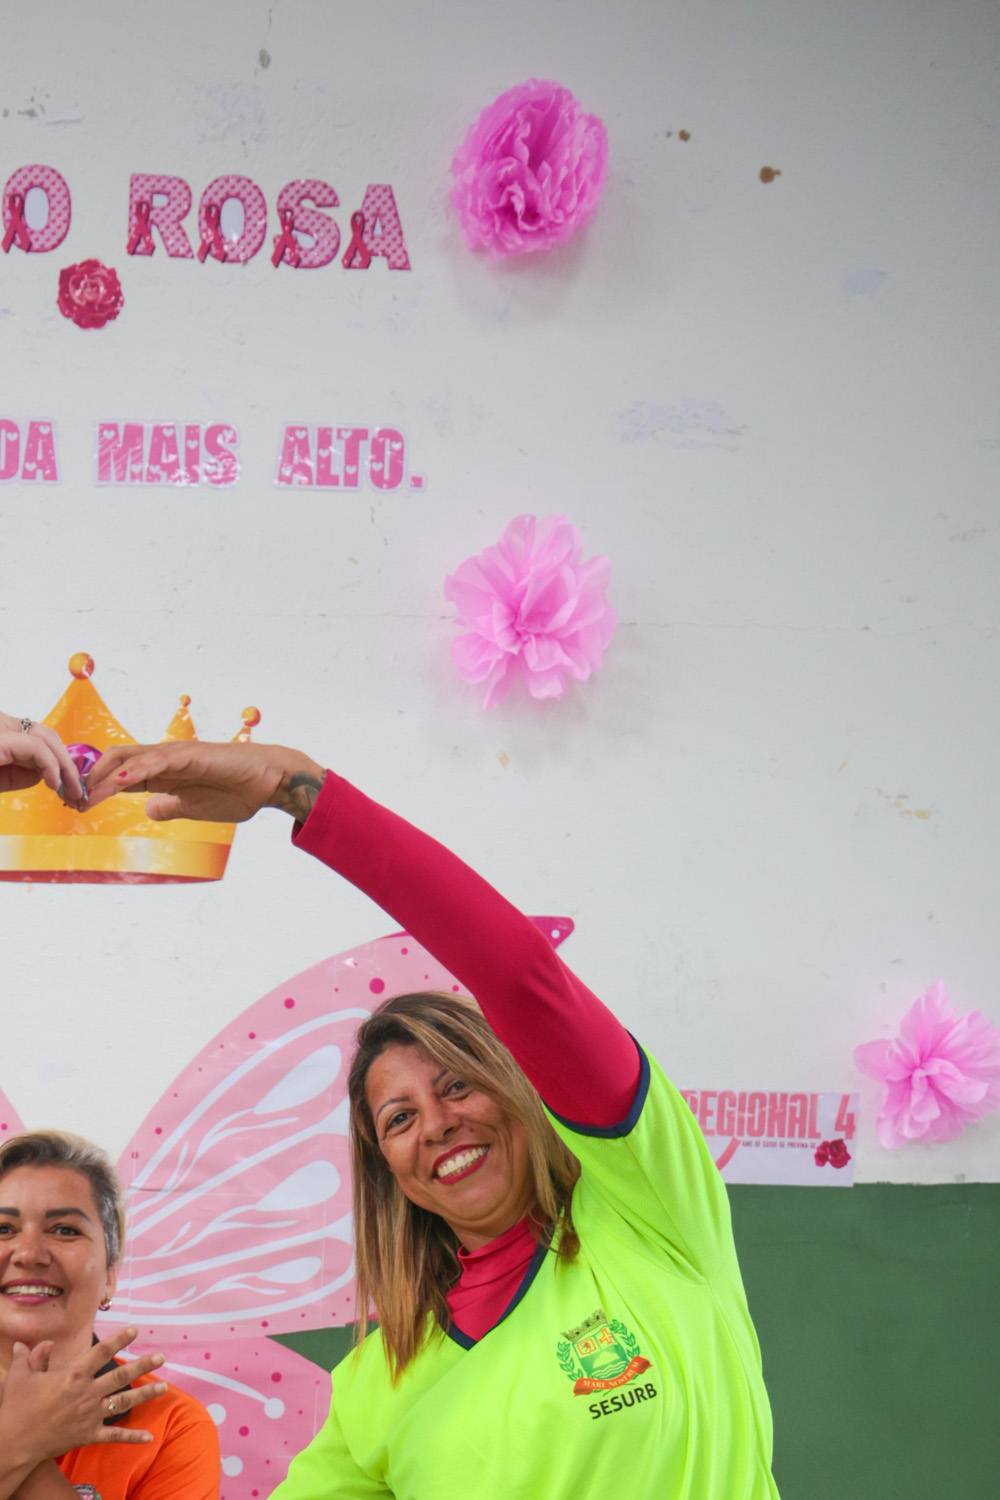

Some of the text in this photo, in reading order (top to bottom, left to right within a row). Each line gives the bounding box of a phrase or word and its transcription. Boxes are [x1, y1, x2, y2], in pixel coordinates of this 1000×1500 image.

[126, 173, 412, 271] ROSA
[97, 422, 239, 485] MAIS
[277, 424, 423, 490] ALTO.
[835, 1094, 856, 1140] 4
[589, 1383, 657, 1419] SESURB
